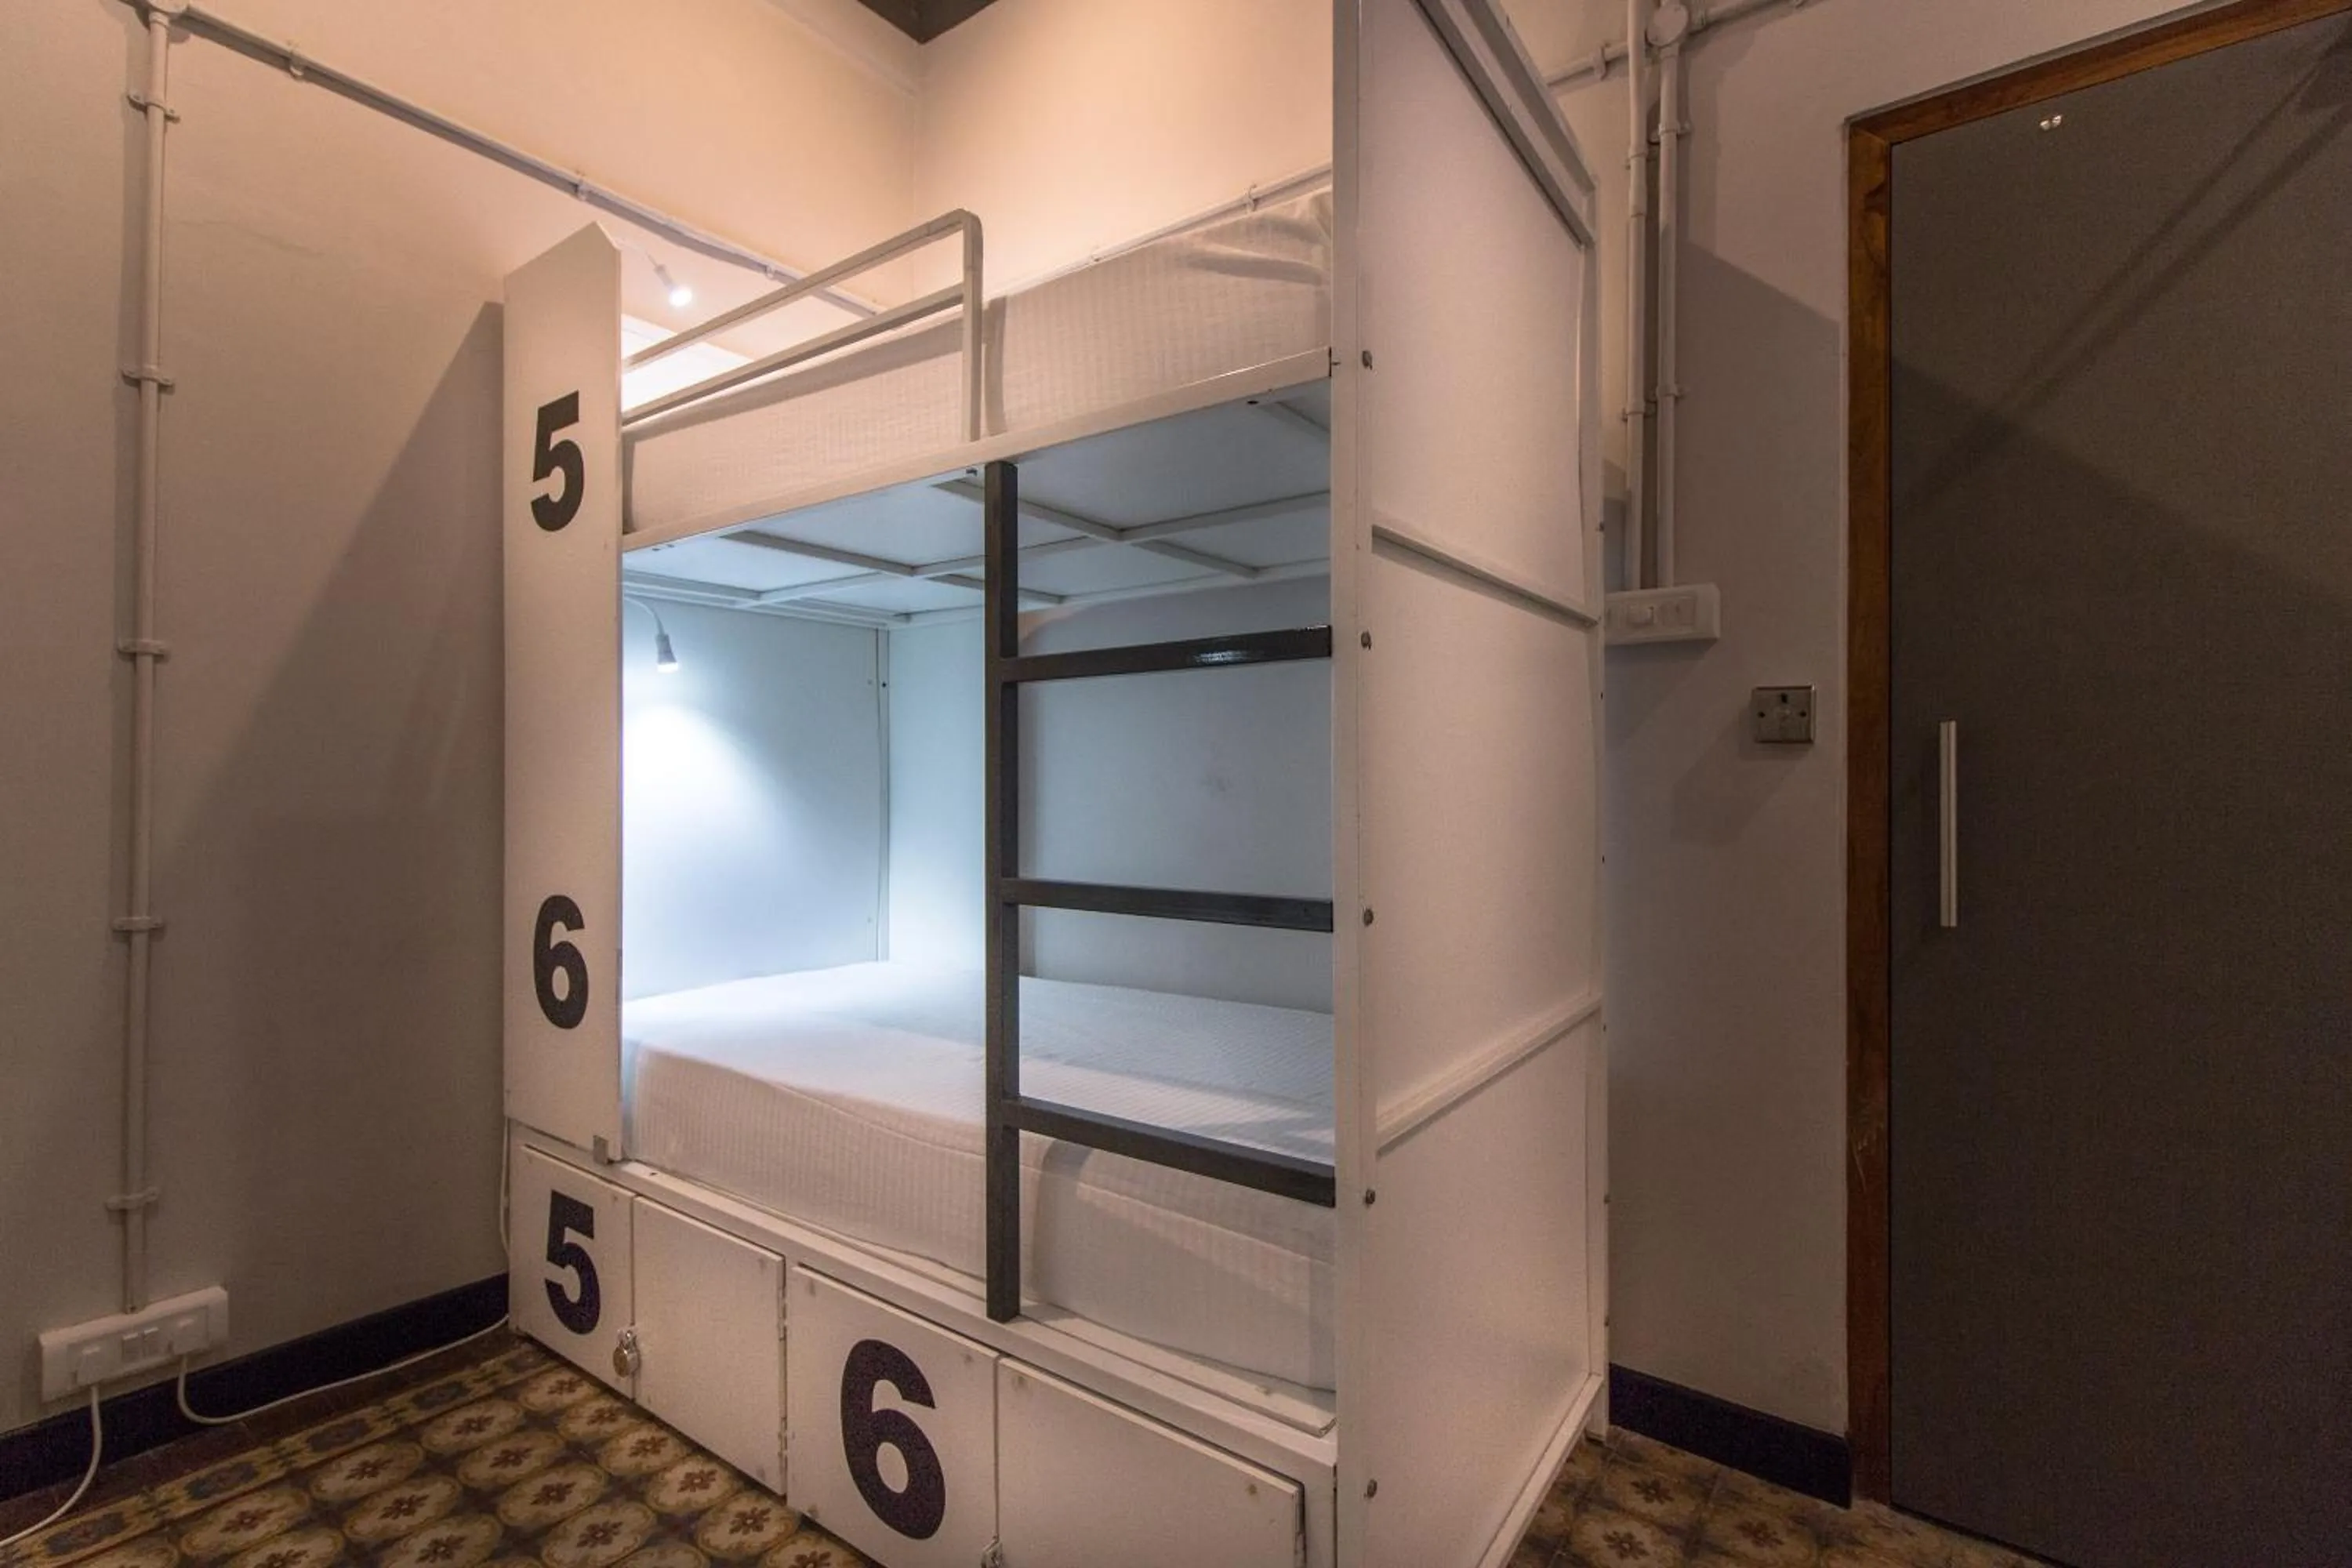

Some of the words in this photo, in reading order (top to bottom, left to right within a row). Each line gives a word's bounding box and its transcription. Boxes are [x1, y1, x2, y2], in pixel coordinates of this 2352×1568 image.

[531, 390, 584, 532] 5
[534, 895, 588, 1030] 6
[545, 1189, 601, 1334] 5
[840, 1338, 946, 1541] 6
